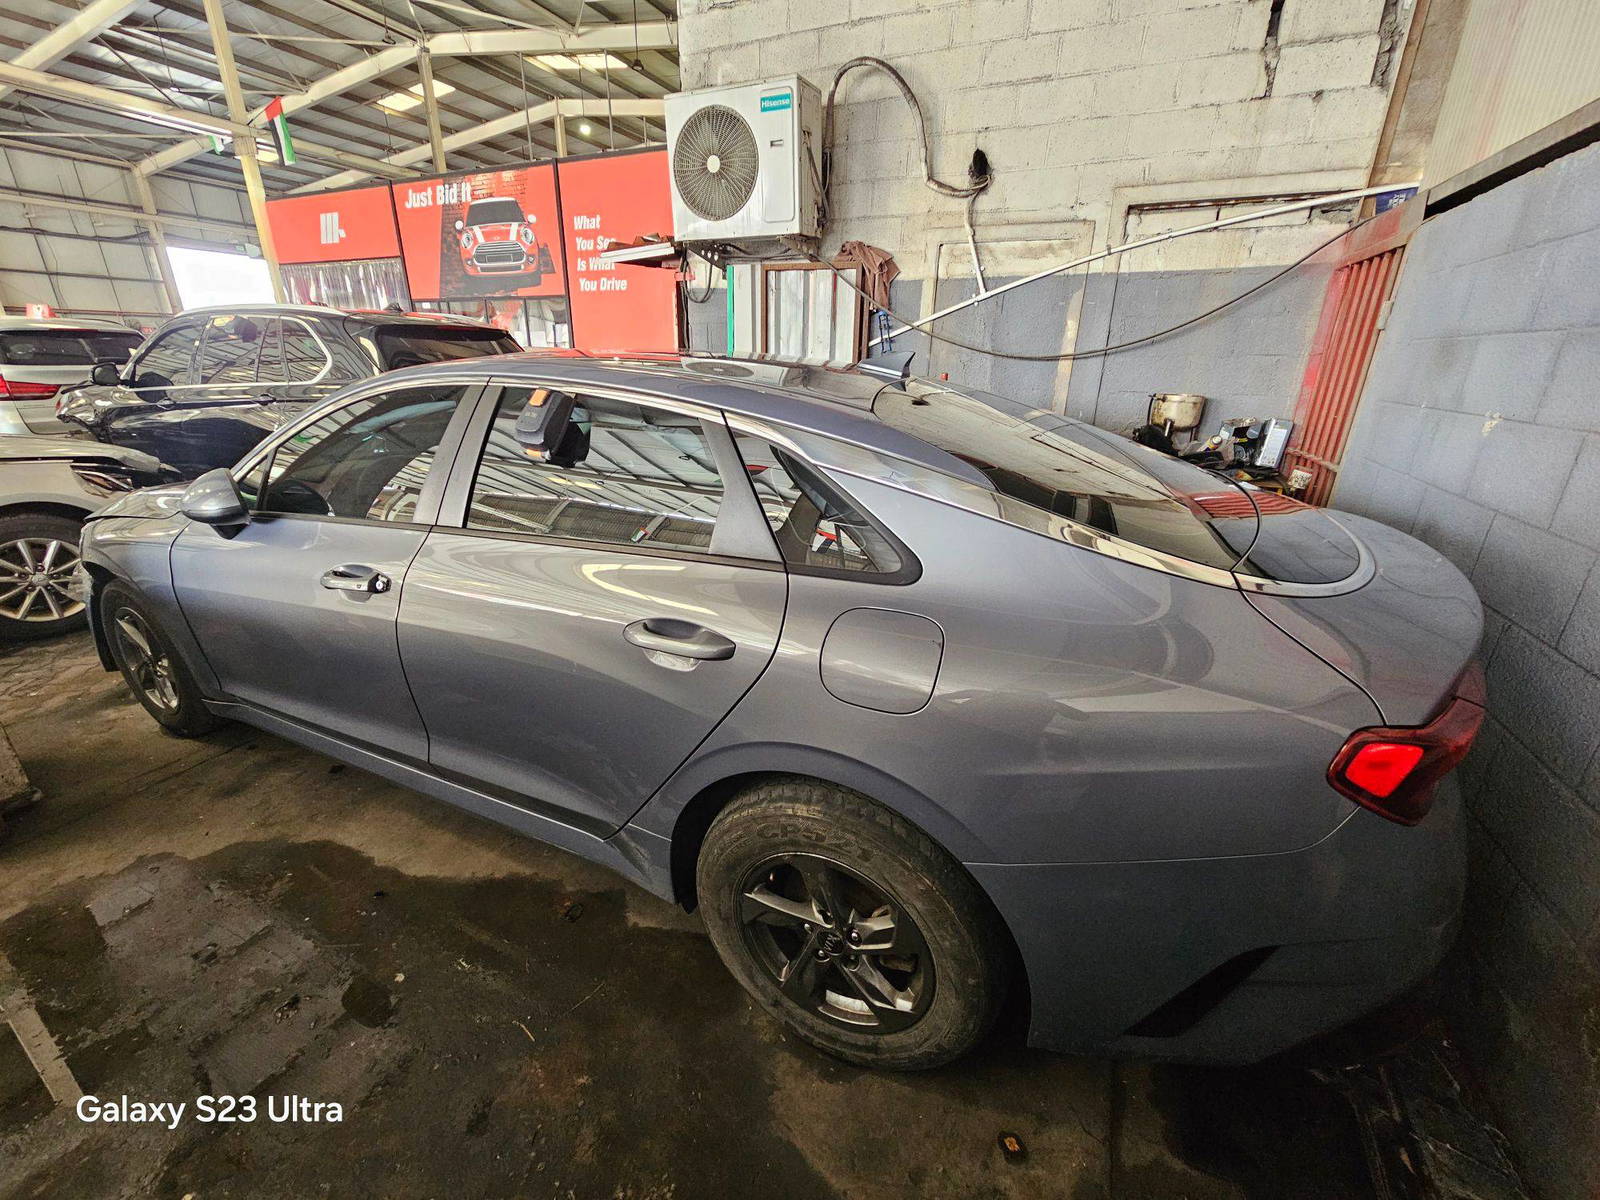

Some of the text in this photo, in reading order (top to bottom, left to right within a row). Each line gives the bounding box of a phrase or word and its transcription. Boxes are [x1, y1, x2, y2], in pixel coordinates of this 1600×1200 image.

[761, 99, 790, 108] Hisense
[405, 182, 472, 209] Just Bid It
[573, 214, 601, 230] What
[575, 236, 594, 251] You
[577, 258, 587, 271] Is
[579, 277, 628, 292] You Drive
